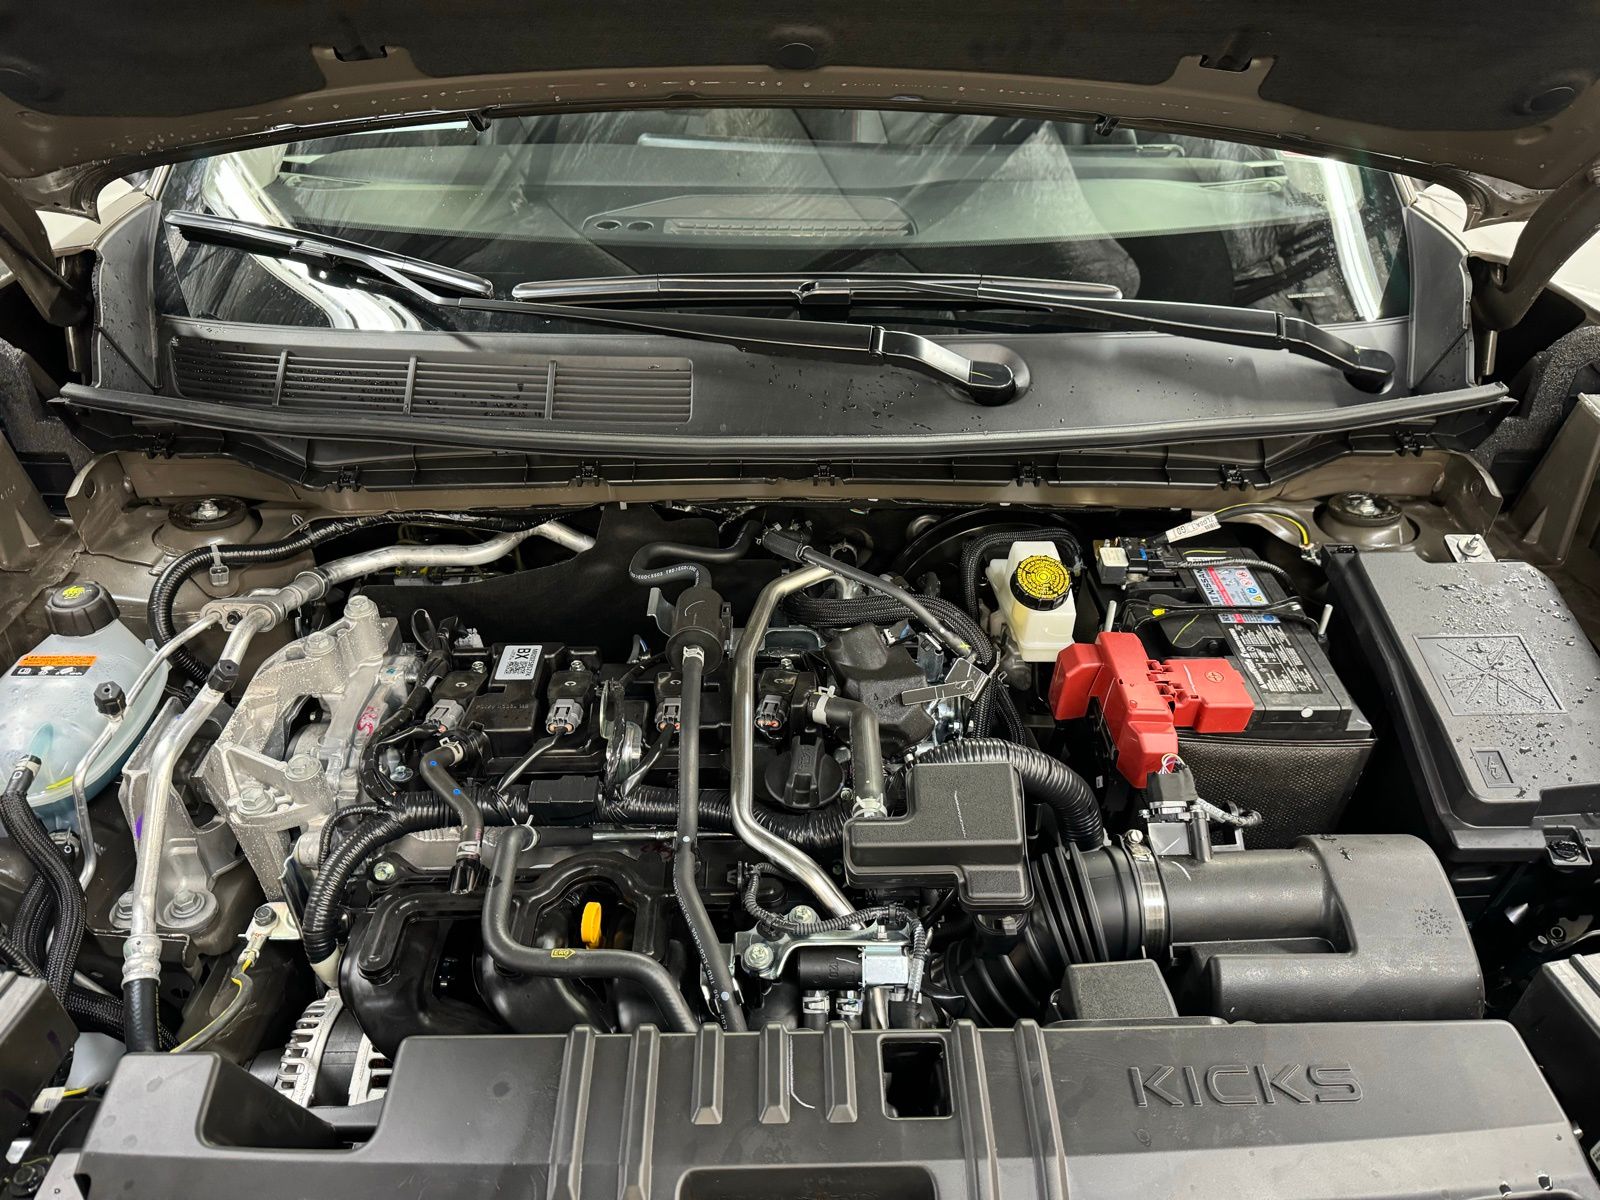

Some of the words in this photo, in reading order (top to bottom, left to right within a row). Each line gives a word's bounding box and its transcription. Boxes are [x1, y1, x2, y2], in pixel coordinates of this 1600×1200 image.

[1195, 568, 1216, 595] NISSAN
[515, 648, 531, 659] BX
[1129, 1064, 1363, 1107] KICKS
